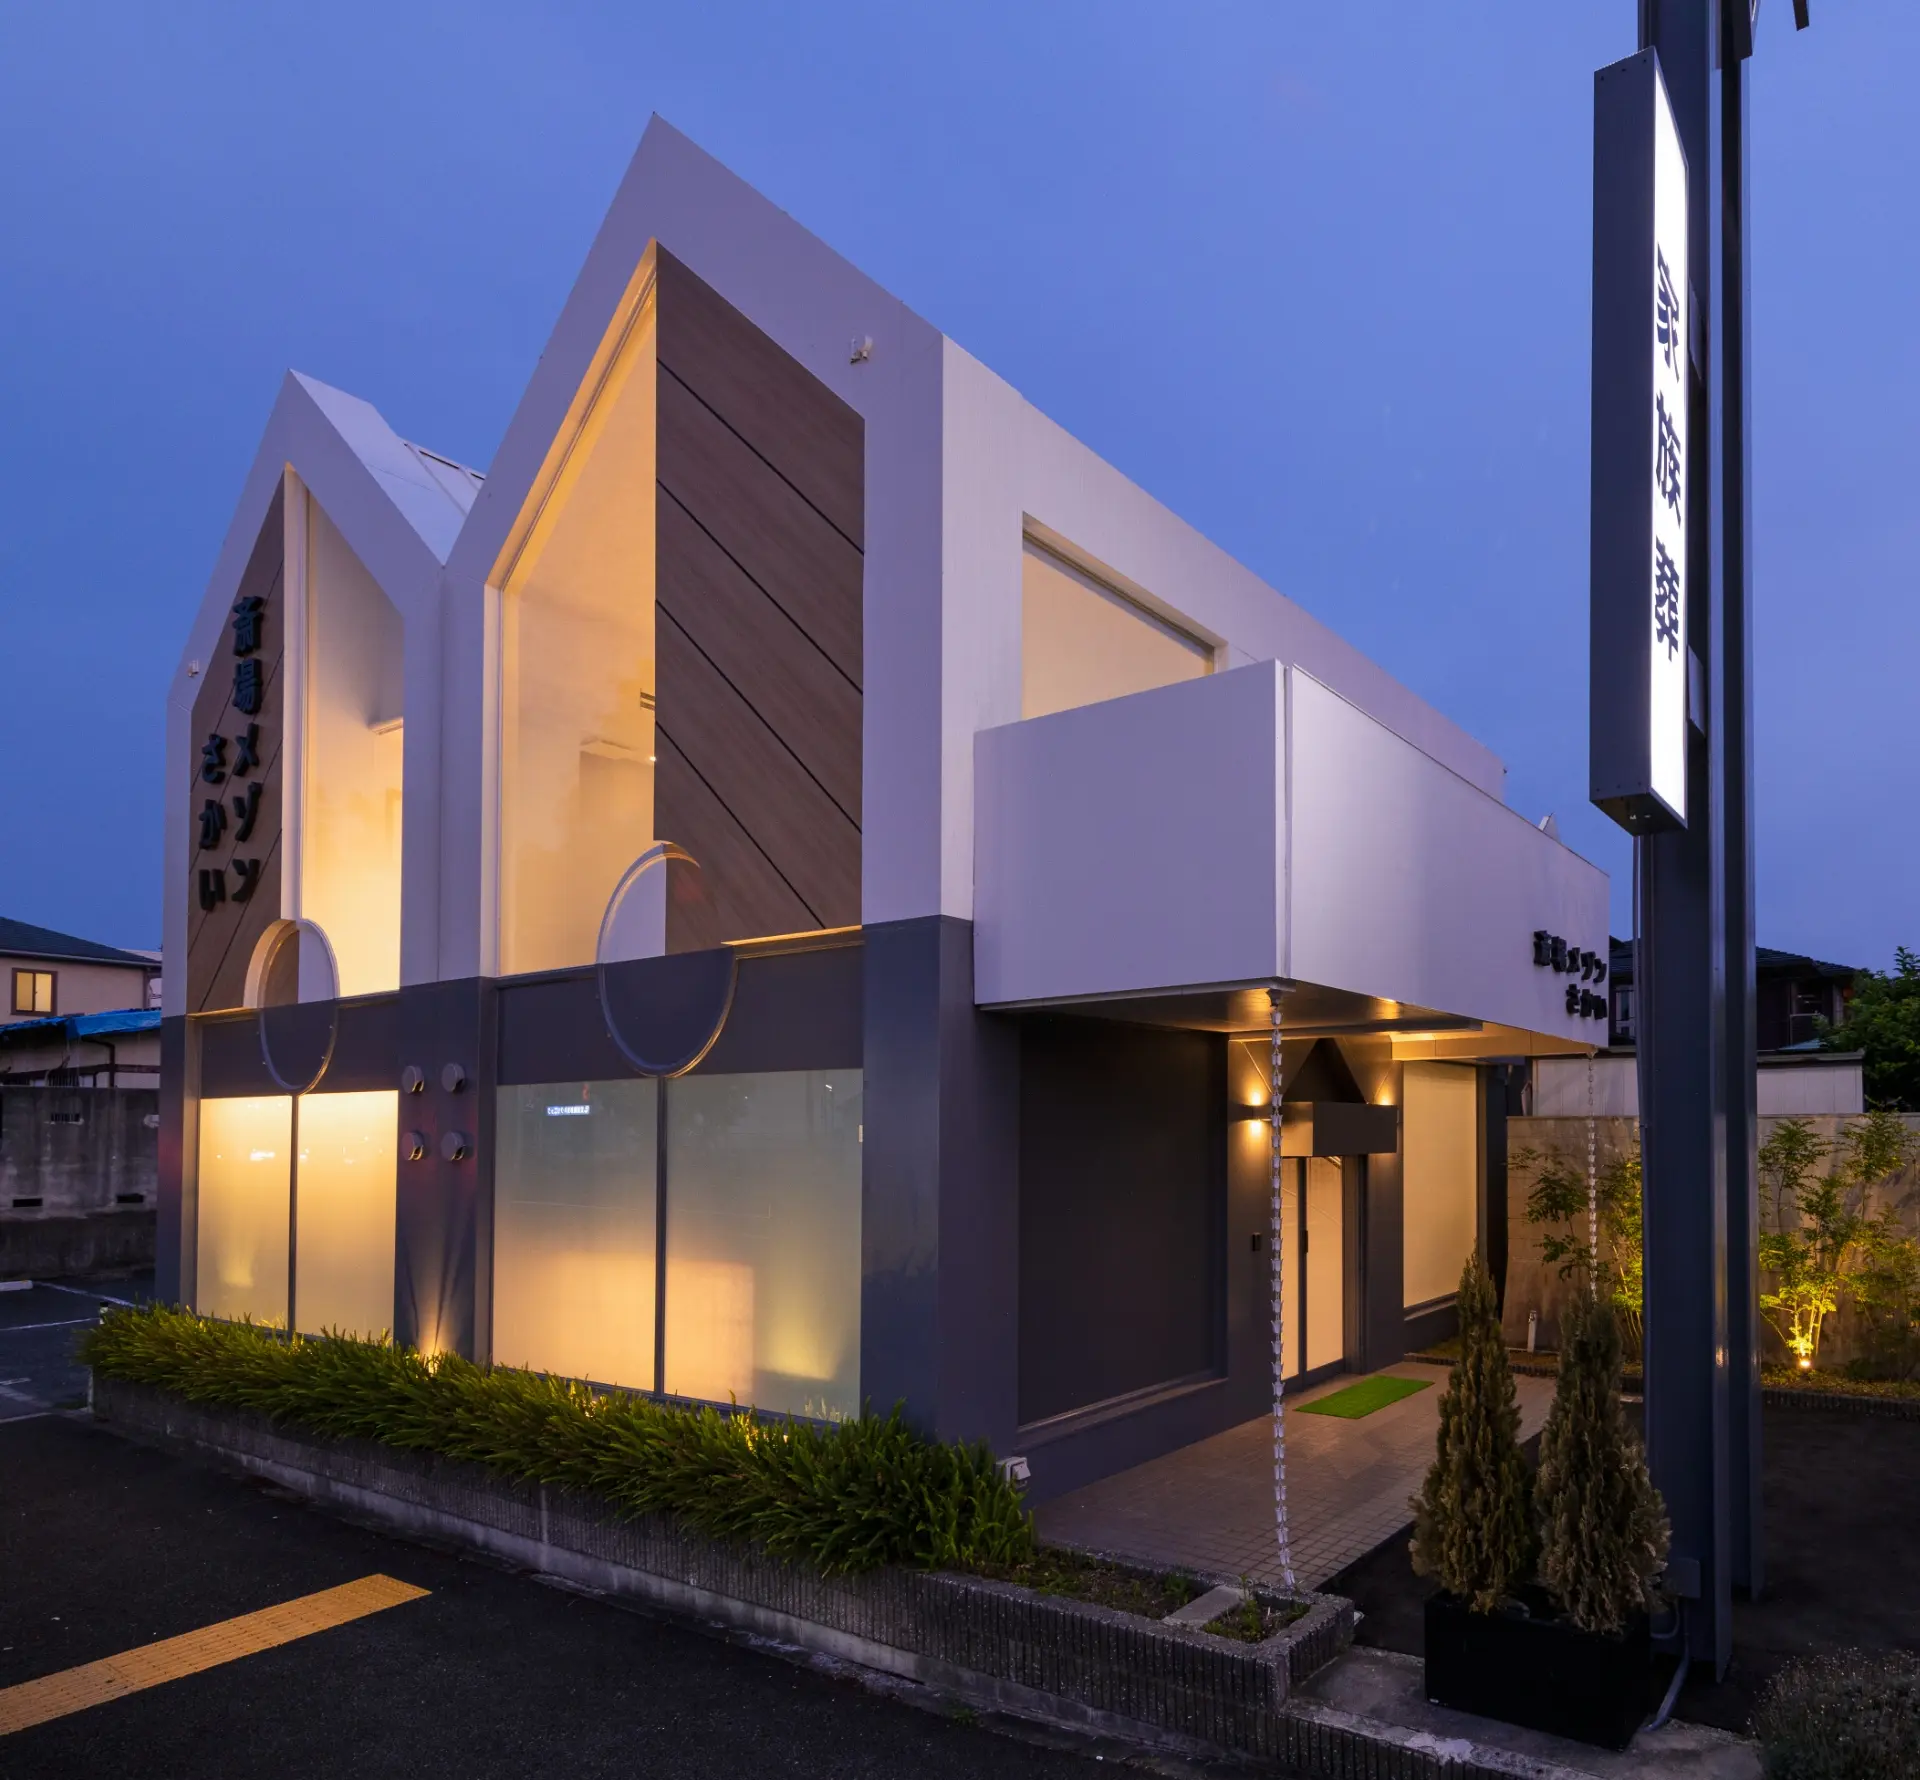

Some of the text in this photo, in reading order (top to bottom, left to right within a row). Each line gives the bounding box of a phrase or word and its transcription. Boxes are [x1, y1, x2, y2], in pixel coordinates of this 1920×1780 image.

[1655, 243, 1681, 660] 家族葬
[199, 734, 227, 912] さかい
